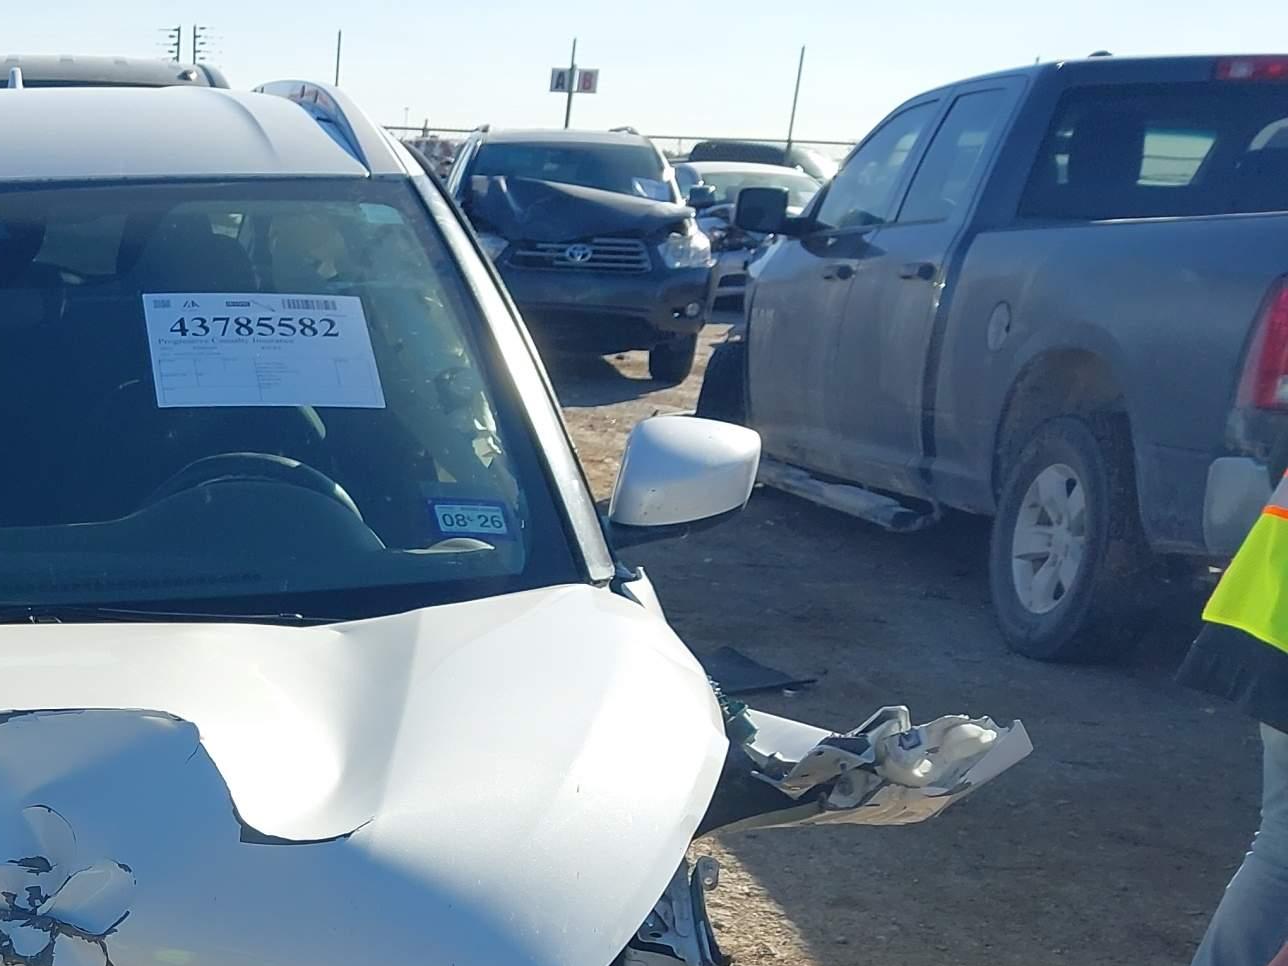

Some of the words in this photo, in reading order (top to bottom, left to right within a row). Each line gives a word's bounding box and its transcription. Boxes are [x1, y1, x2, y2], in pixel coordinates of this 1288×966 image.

[554, 71, 565, 90] A
[582, 71, 594, 90] B
[169, 316, 340, 337] 43785582
[441, 513, 468, 528] 08
[477, 514, 503, 529] 26
